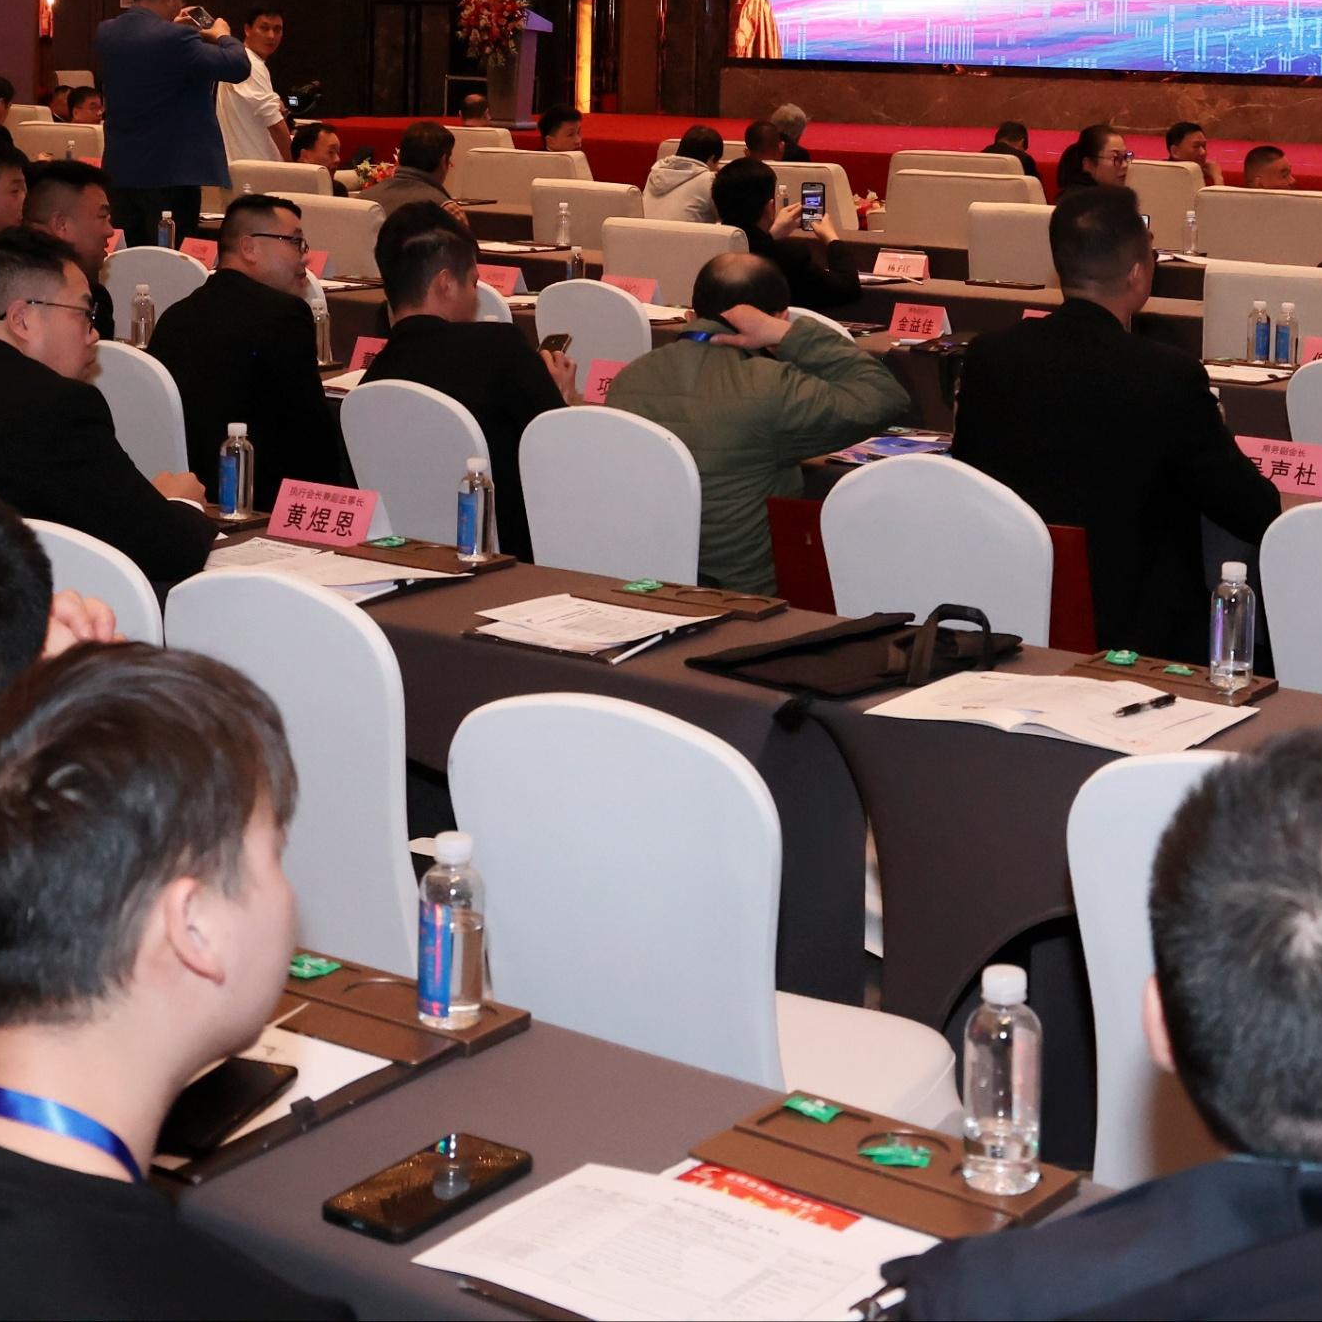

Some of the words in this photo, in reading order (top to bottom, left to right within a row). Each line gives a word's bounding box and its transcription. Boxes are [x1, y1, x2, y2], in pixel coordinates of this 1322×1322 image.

[897, 317, 934, 335] 金益佳
[283, 502, 355, 537] 黄煜恩
